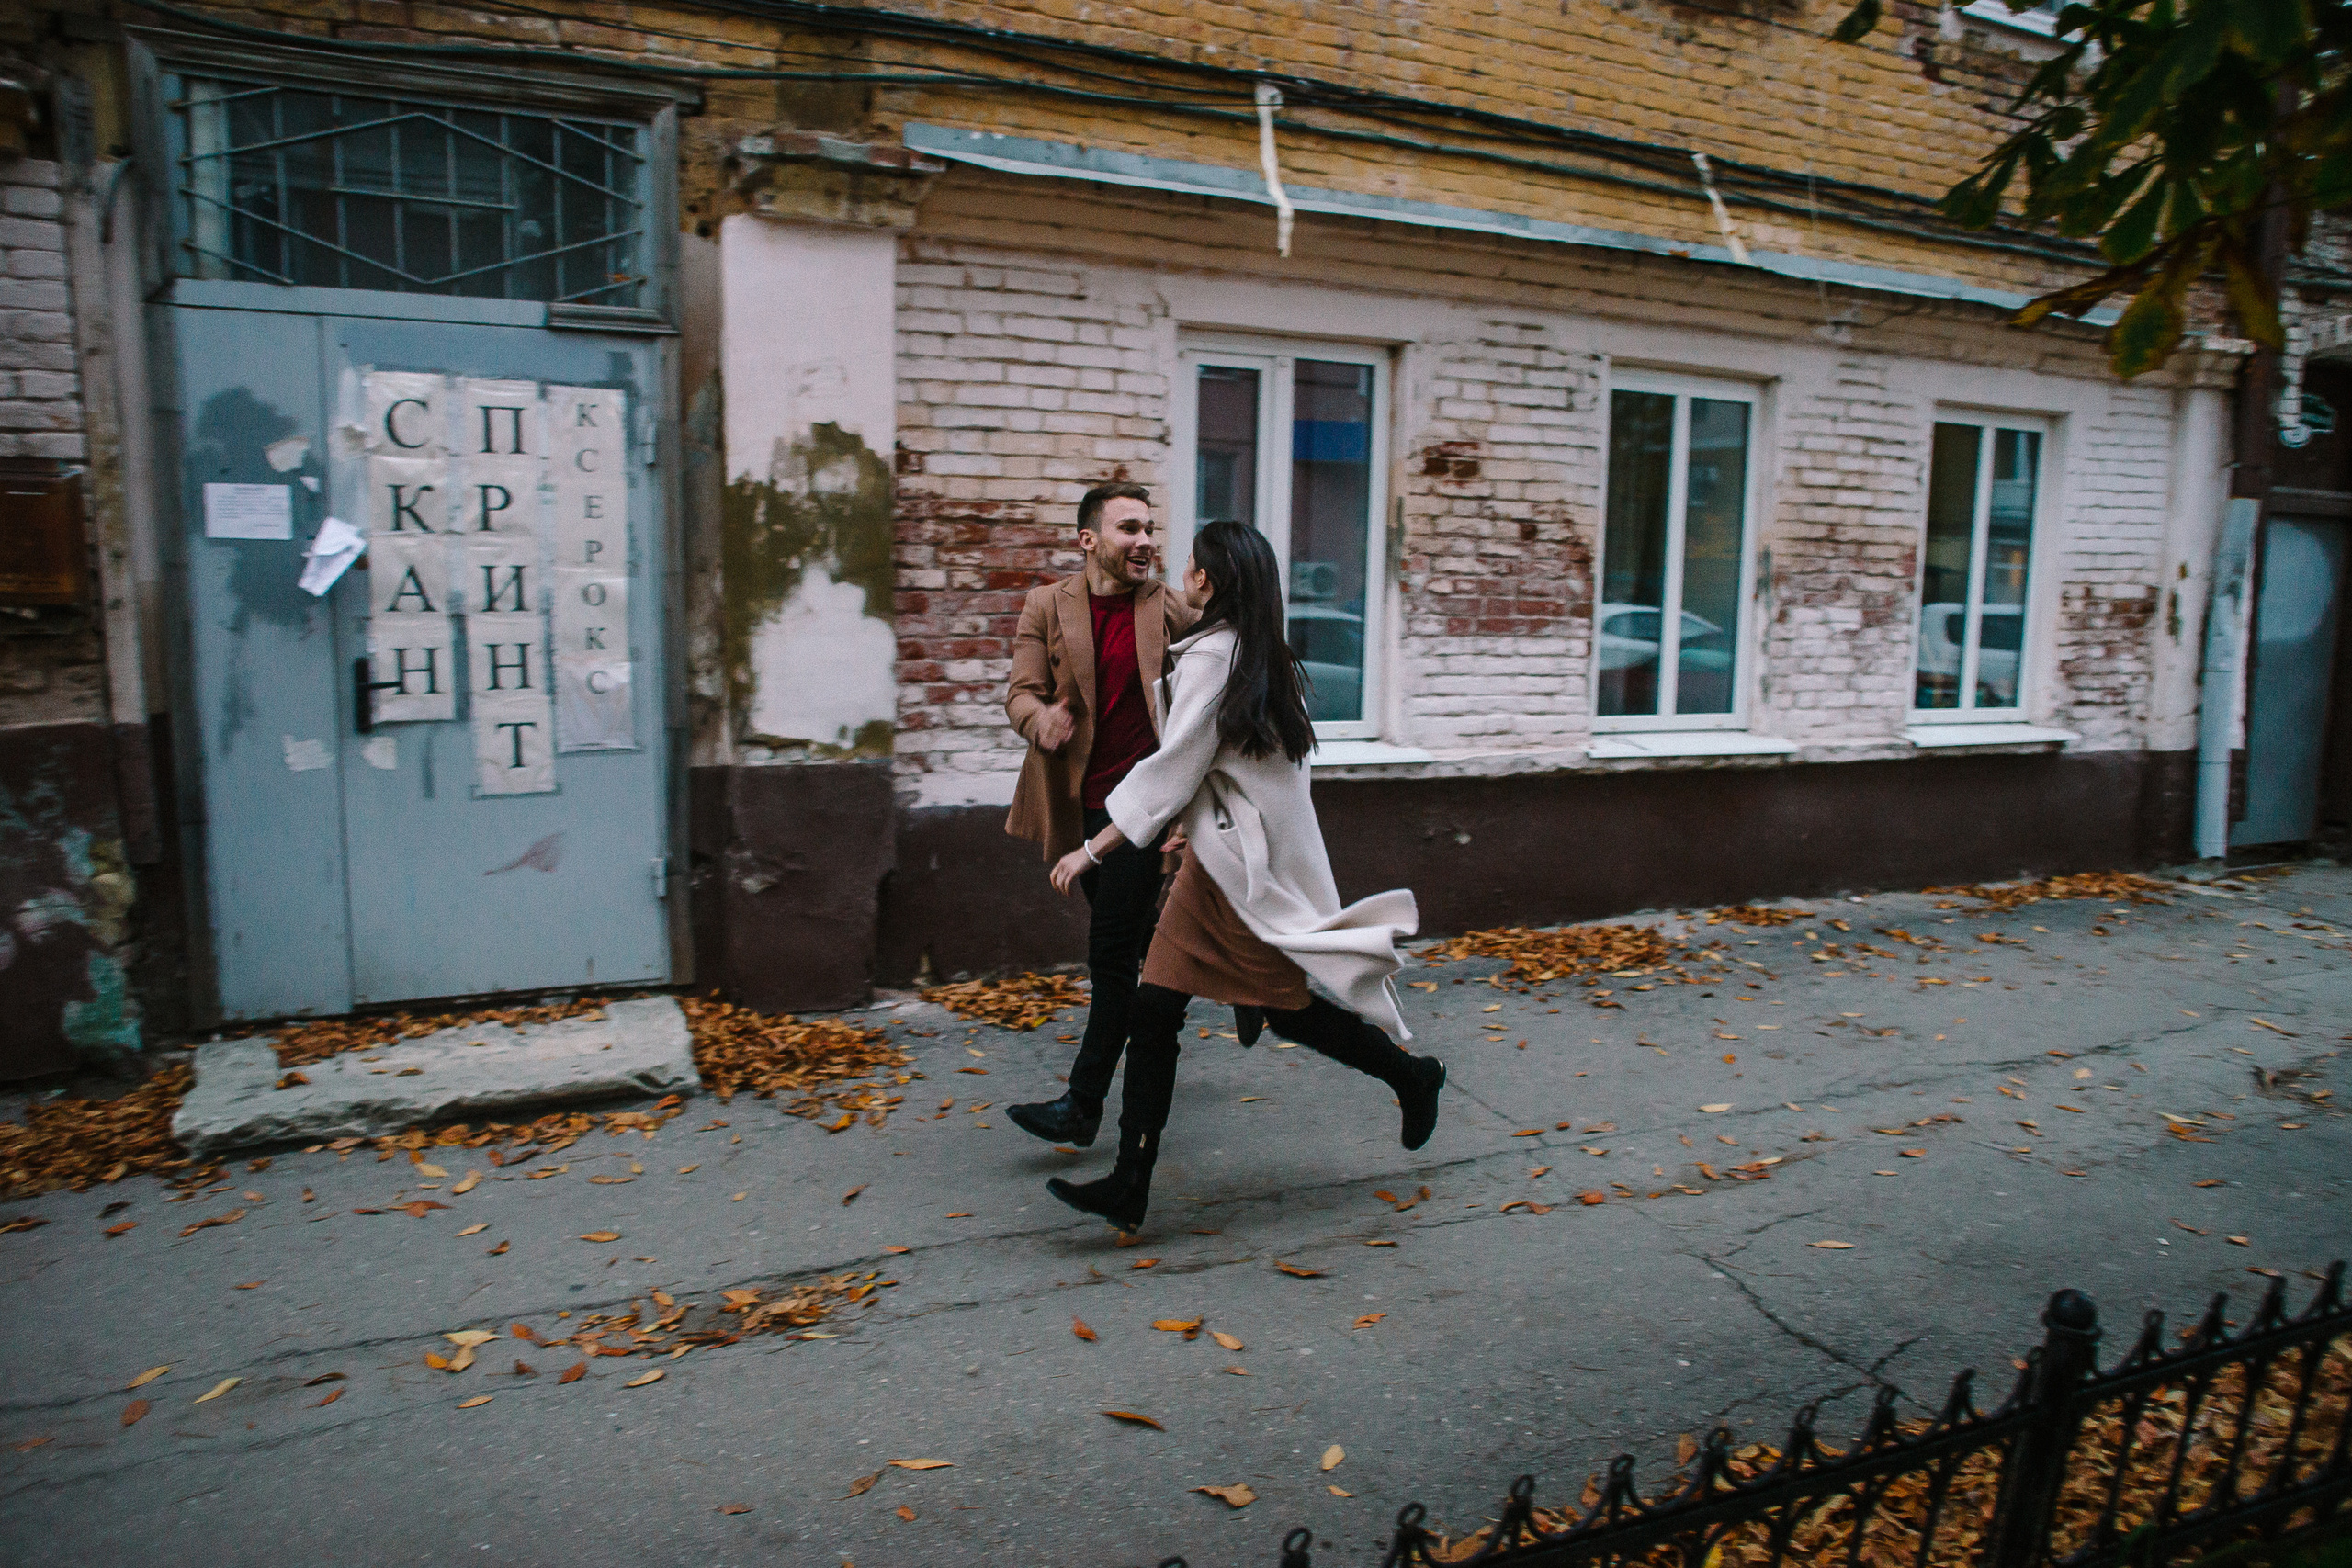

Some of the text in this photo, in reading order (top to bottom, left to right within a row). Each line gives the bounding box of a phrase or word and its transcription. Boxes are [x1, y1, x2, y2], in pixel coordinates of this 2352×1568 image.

[385, 399, 443, 695] СКАН
[476, 405, 537, 769] ПРИНТ
[575, 402, 610, 694] КСЕРОКС
